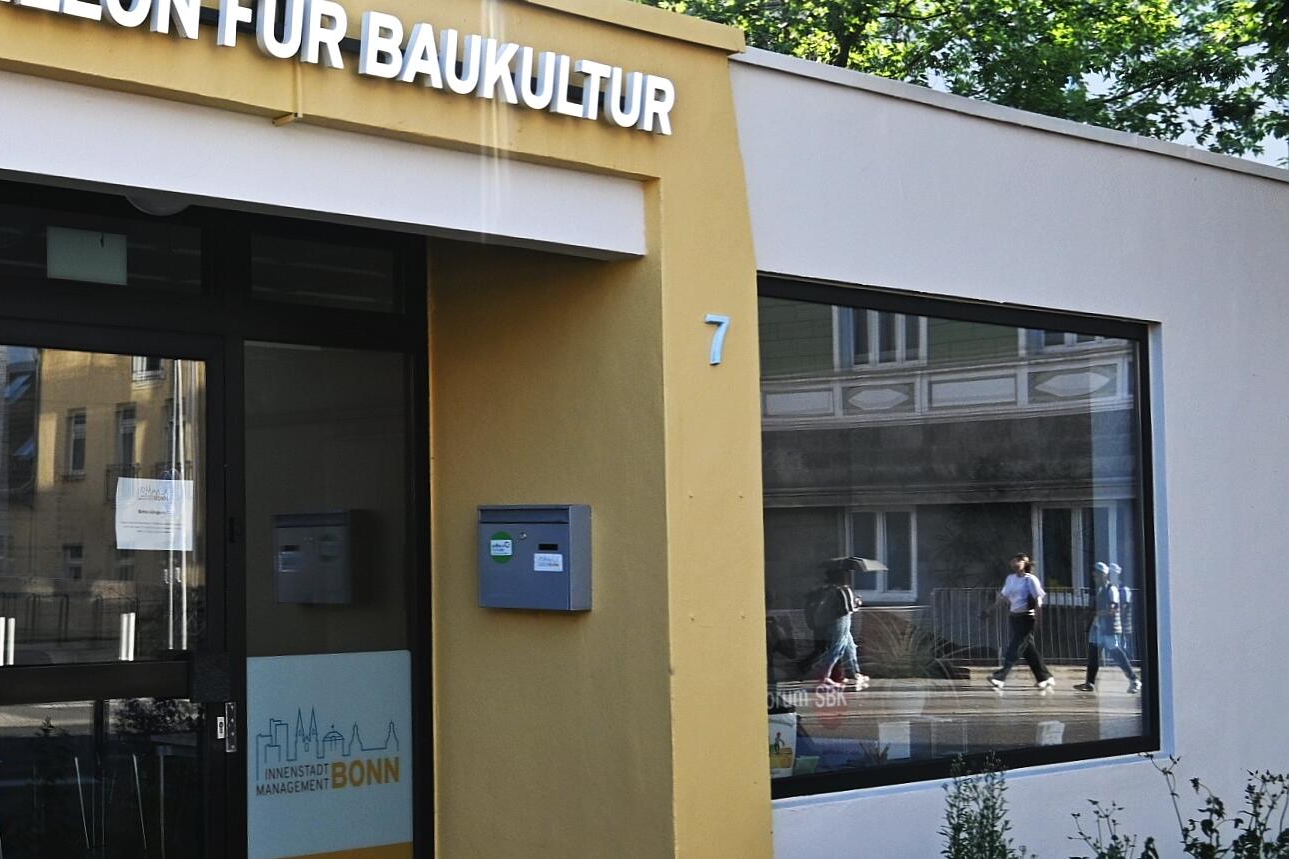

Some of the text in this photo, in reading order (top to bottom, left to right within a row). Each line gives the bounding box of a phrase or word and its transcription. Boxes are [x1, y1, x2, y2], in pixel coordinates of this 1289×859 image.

[358, 10, 676, 135] BAUKULTUR
[705, 313, 730, 366] 7
[256, 778, 330, 796] MANAGEMENT
[265, 763, 330, 781] INNENSTADT
[331, 756, 401, 789] BONN
